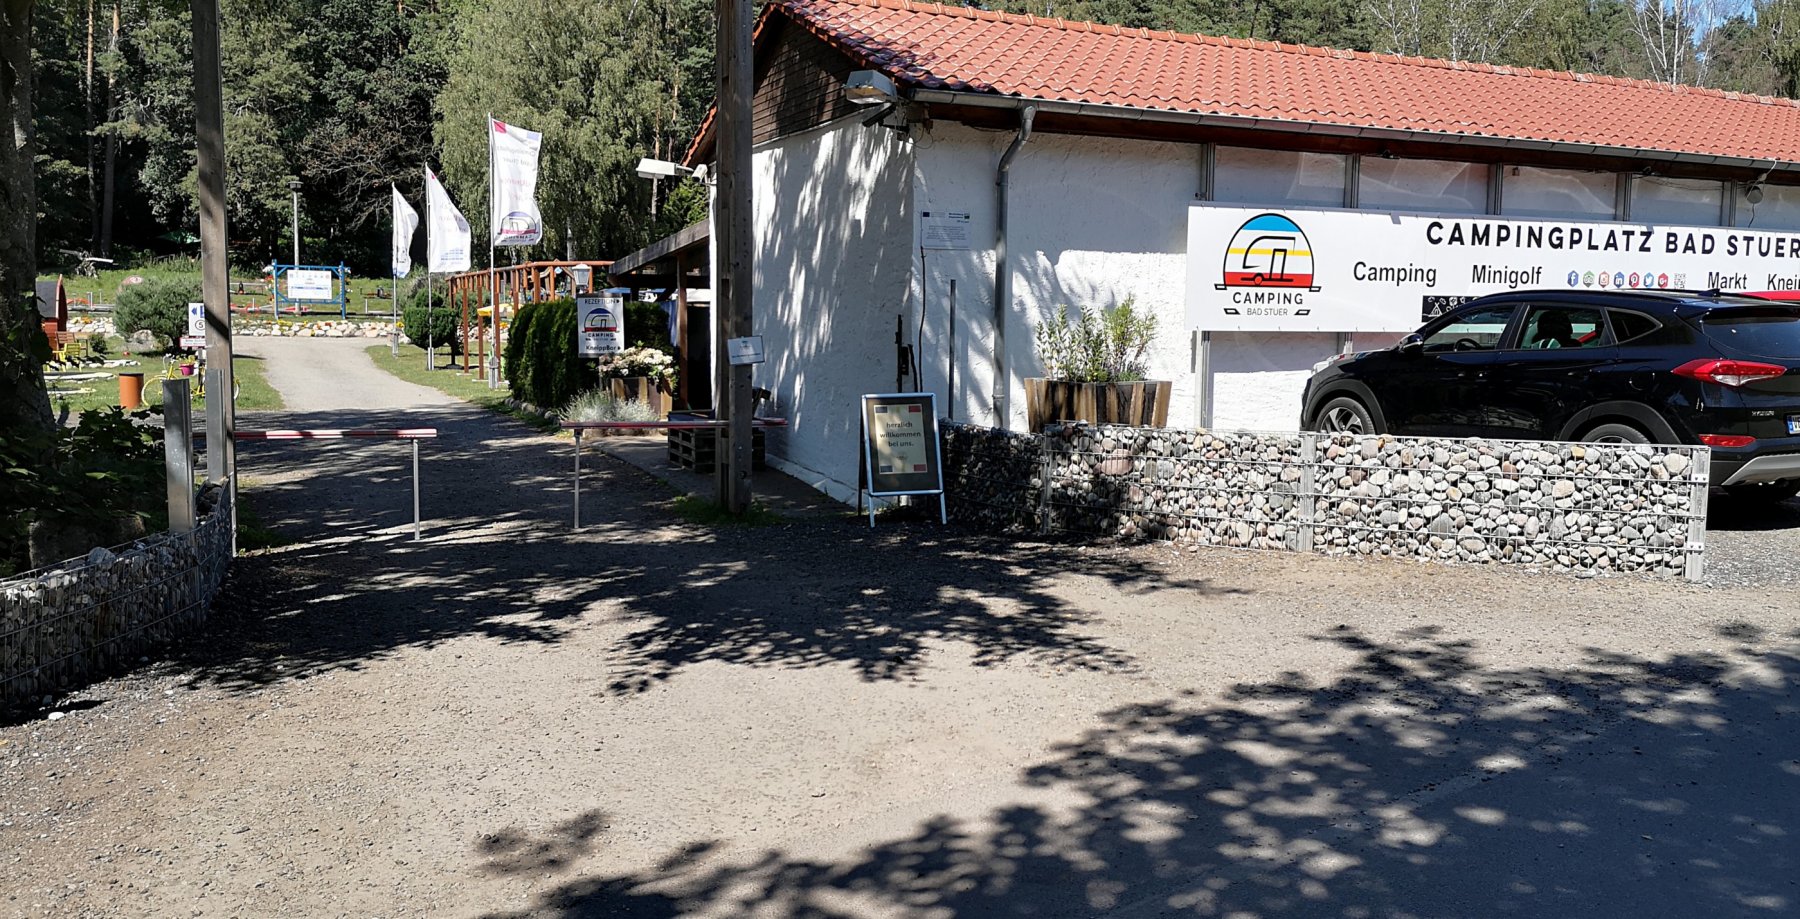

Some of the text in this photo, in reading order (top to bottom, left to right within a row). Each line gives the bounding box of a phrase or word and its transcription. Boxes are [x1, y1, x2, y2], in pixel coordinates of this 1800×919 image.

[1426, 221, 1800, 258] CAMPINGPLATZ BAD STUER
[1353, 261, 1543, 289] Camping Minigolf
[1708, 271, 1800, 290] Markt Knei
[1232, 292, 1304, 305] CAMPING
[1246, 308, 1289, 316] BAD STUER
